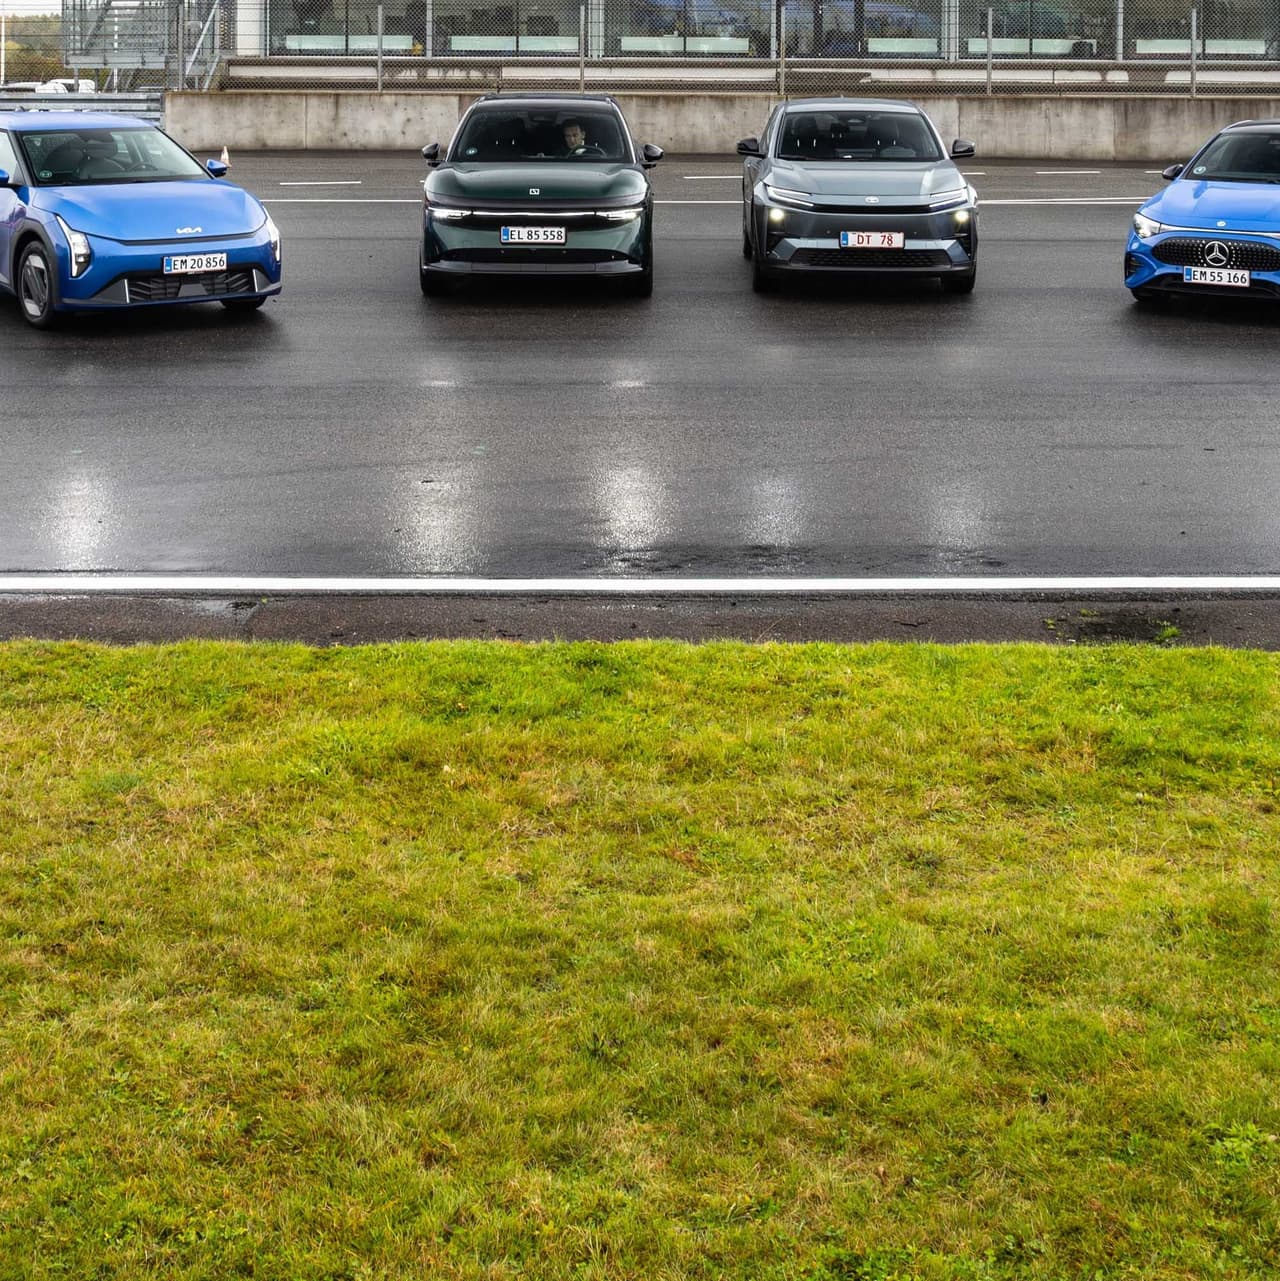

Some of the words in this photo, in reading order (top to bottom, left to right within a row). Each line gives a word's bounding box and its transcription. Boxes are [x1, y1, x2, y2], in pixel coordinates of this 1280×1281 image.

[510, 230, 523, 240] EL
[526, 230, 540, 240] 85
[543, 230, 563, 240] 558
[857, 235, 872, 245] DT
[880, 235, 893, 246] 78
[173, 259, 188, 270] EM
[190, 258, 203, 269] 20
[205, 256, 225, 268] 856
[1192, 270, 1207, 281] EM
[1210, 271, 1223, 282] 55
[1227, 272, 1247, 284] 166
